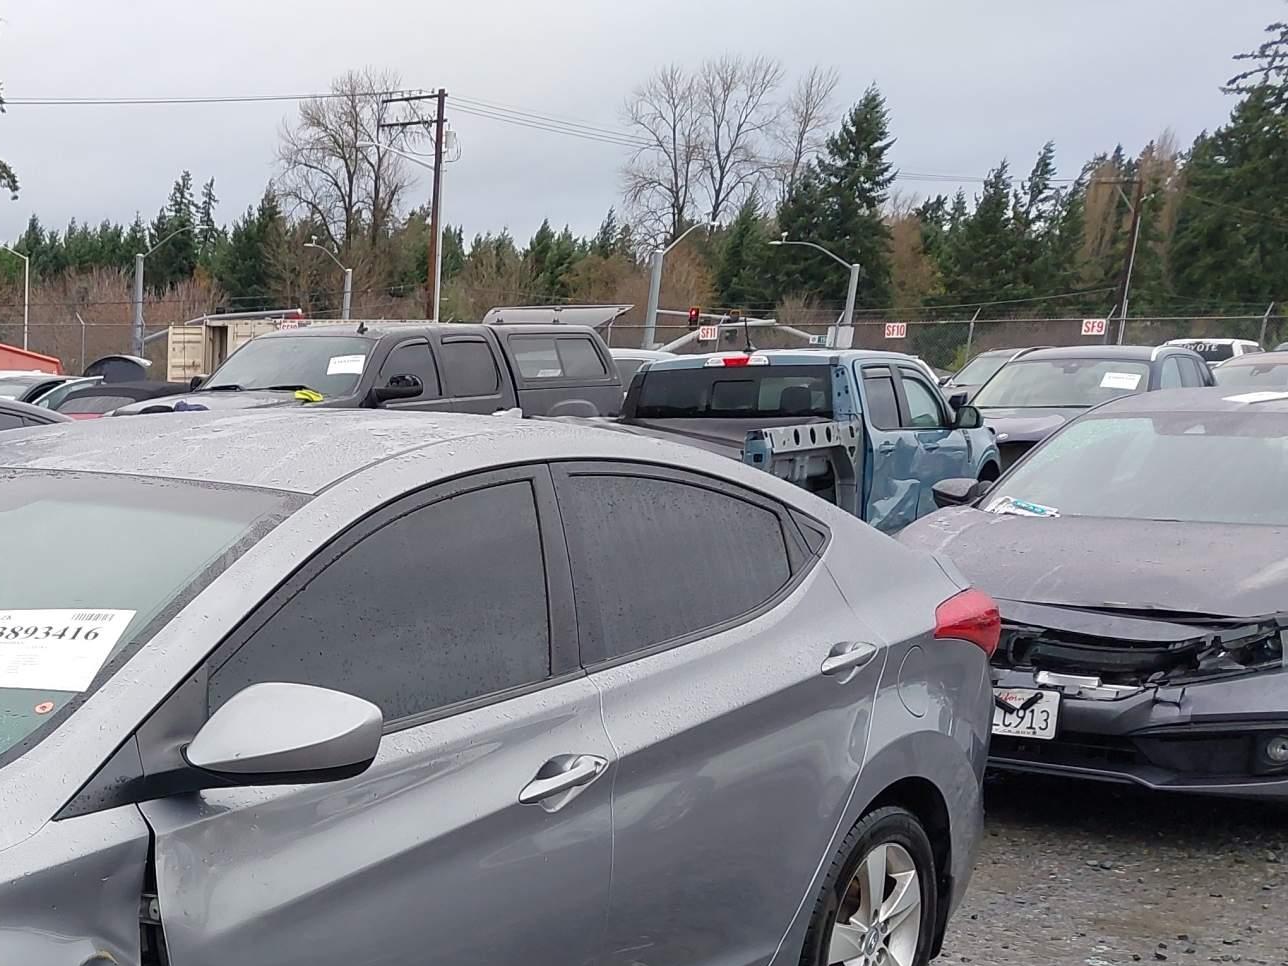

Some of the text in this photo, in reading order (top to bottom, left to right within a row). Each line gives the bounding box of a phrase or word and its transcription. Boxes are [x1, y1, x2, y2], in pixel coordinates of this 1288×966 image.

[700, 326, 717, 339] SF11
[886, 324, 906, 337] SF10
[1083, 321, 1104, 334] SF9
[992, 708, 1051, 731] C913
